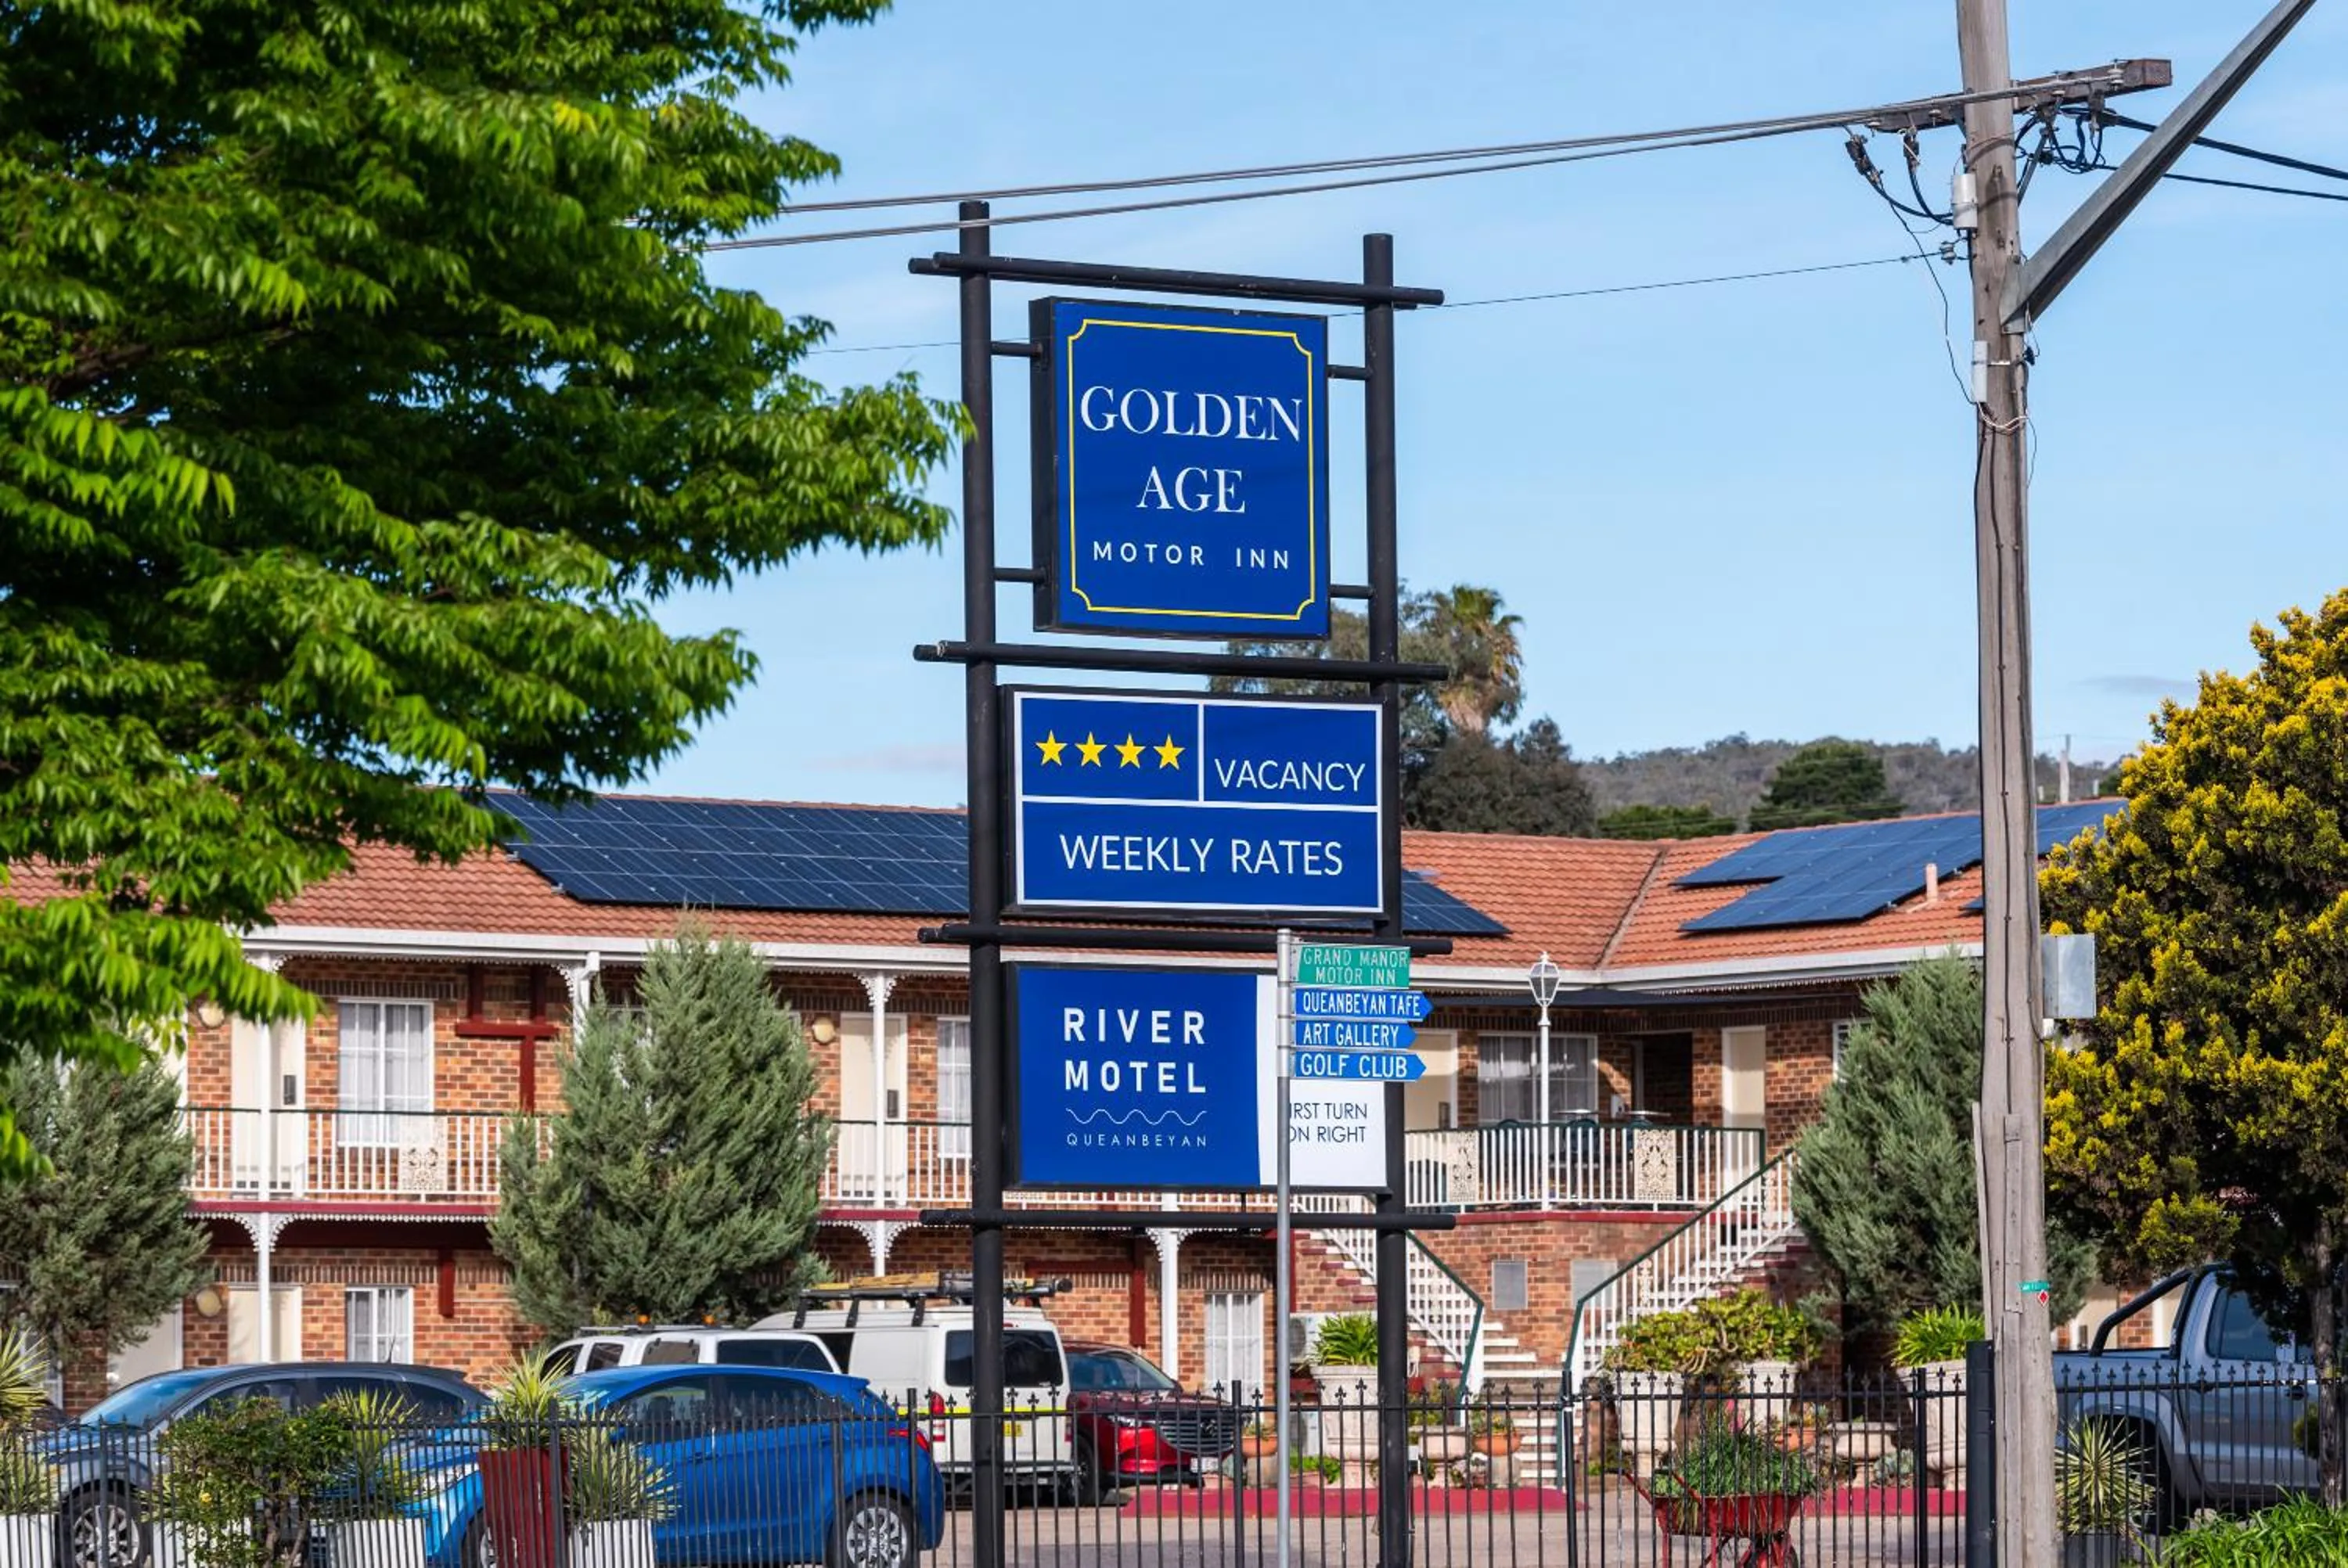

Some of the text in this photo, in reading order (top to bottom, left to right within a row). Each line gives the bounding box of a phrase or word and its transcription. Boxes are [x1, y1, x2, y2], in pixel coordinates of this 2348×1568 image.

[1080, 386, 1302, 442] GOLDEN
[1136, 466, 1245, 513] AGE
[1093, 541, 1289, 569] MOTOR INN
[1214, 758, 1366, 792] VACANCY
[1059, 834, 1343, 876] WEEKLY RATES
[1303, 948, 1408, 968] GRAND MANOR
[1316, 966, 1395, 985] MOTOR INN
[1303, 991, 1421, 1016] QUEANBEYAN TAFE
[1063, 1007, 1205, 1045] RIVER
[1303, 1023, 1399, 1048] ART GALLERY
[1064, 1059, 1206, 1093] MOTEL
[1300, 1052, 1407, 1079] GOLF CLUB
[1289, 1102, 1367, 1120] IRST TURN
[1067, 1133, 1207, 1146] QUEANBEYAN
[1317, 1125, 1366, 1144] RIGHT
